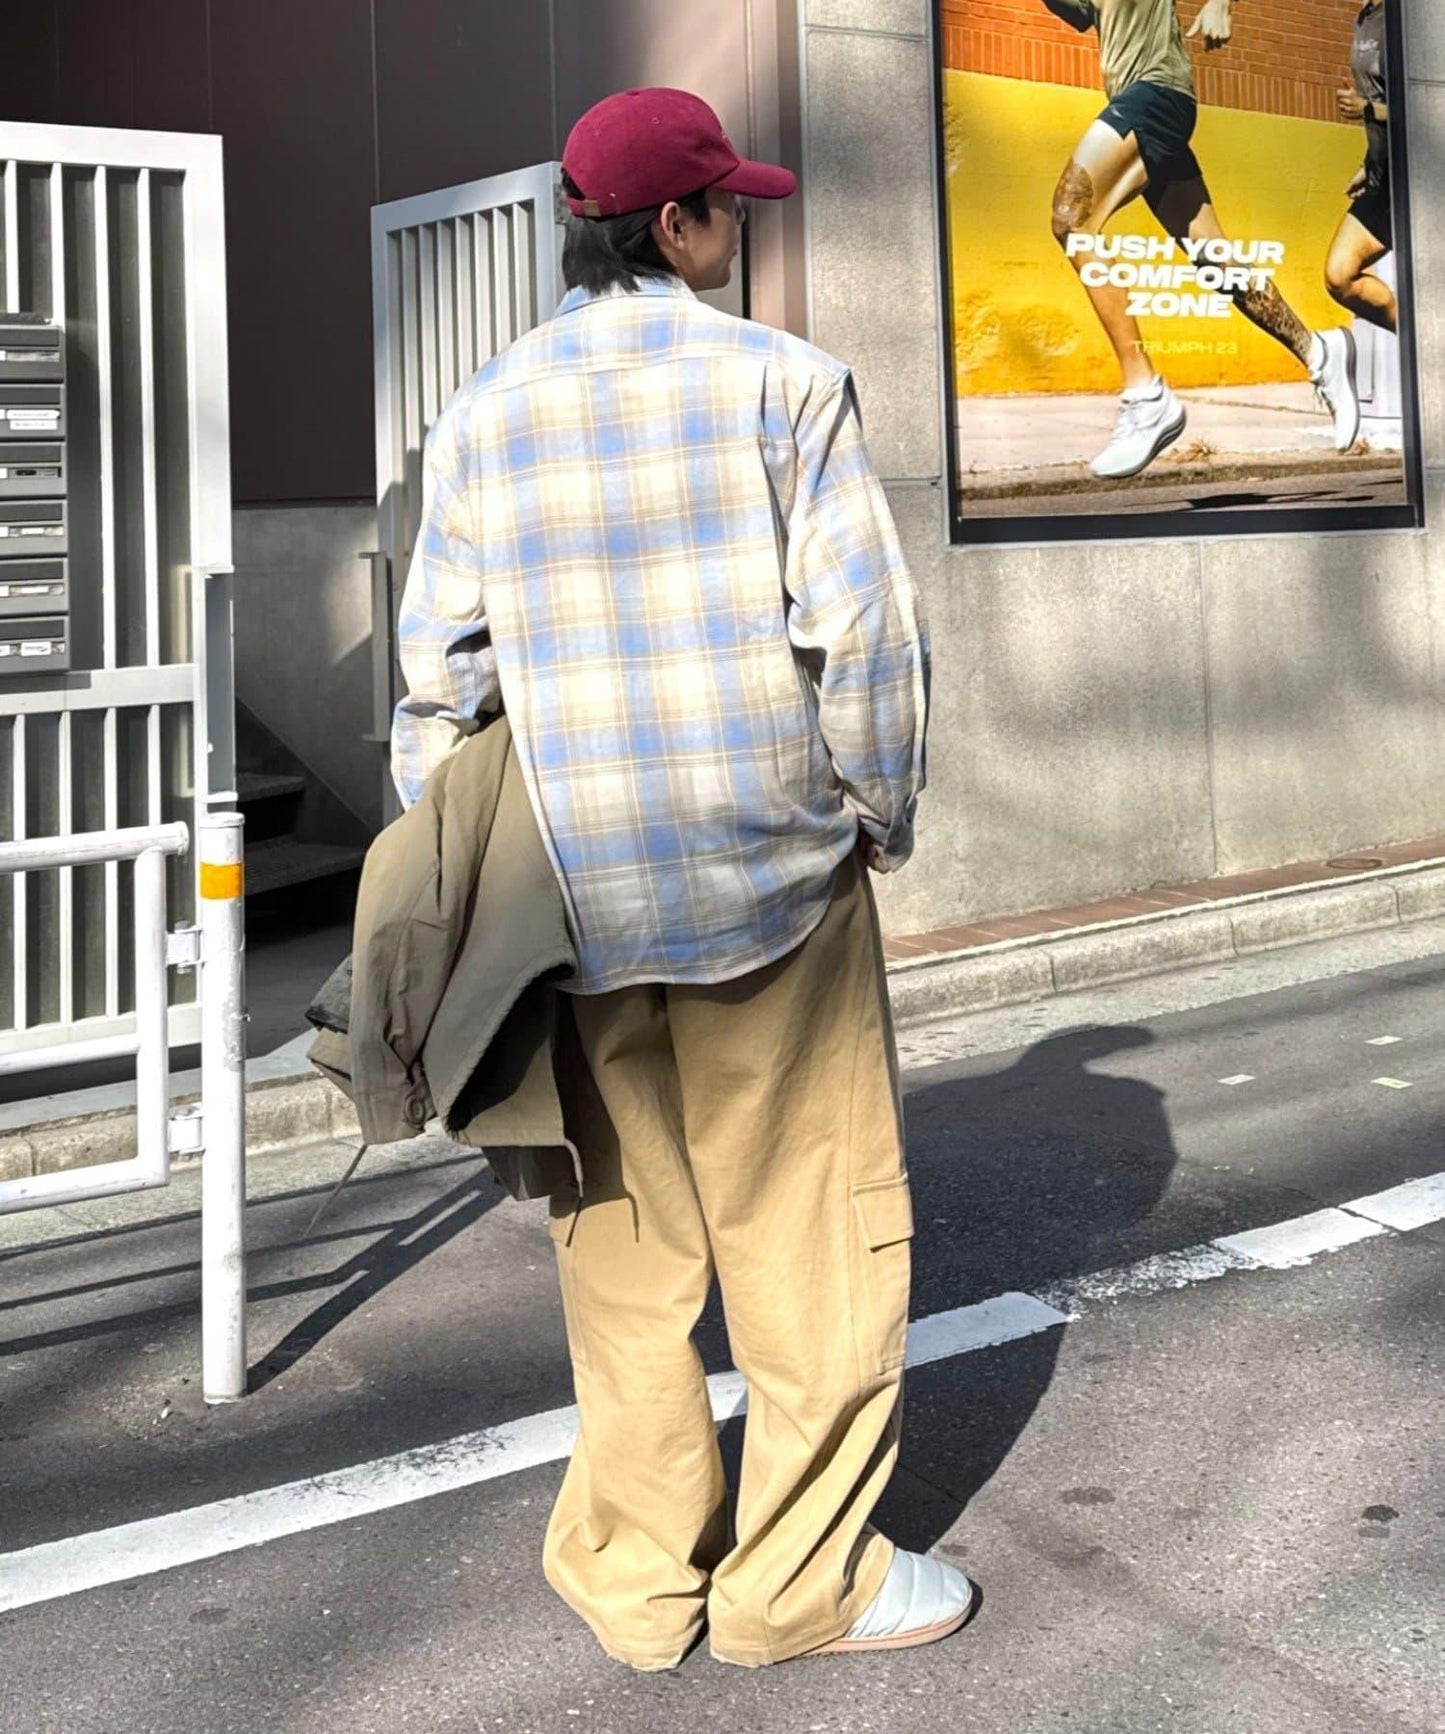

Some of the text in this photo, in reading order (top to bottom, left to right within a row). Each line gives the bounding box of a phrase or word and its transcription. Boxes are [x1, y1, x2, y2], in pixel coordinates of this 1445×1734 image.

[1066, 233, 1285, 264] PUSH YOUR
[1080, 261, 1275, 291] COMFORT
[1125, 292, 1233, 317] ZONE
[1133, 340, 1238, 354] TRIUMPH 23
